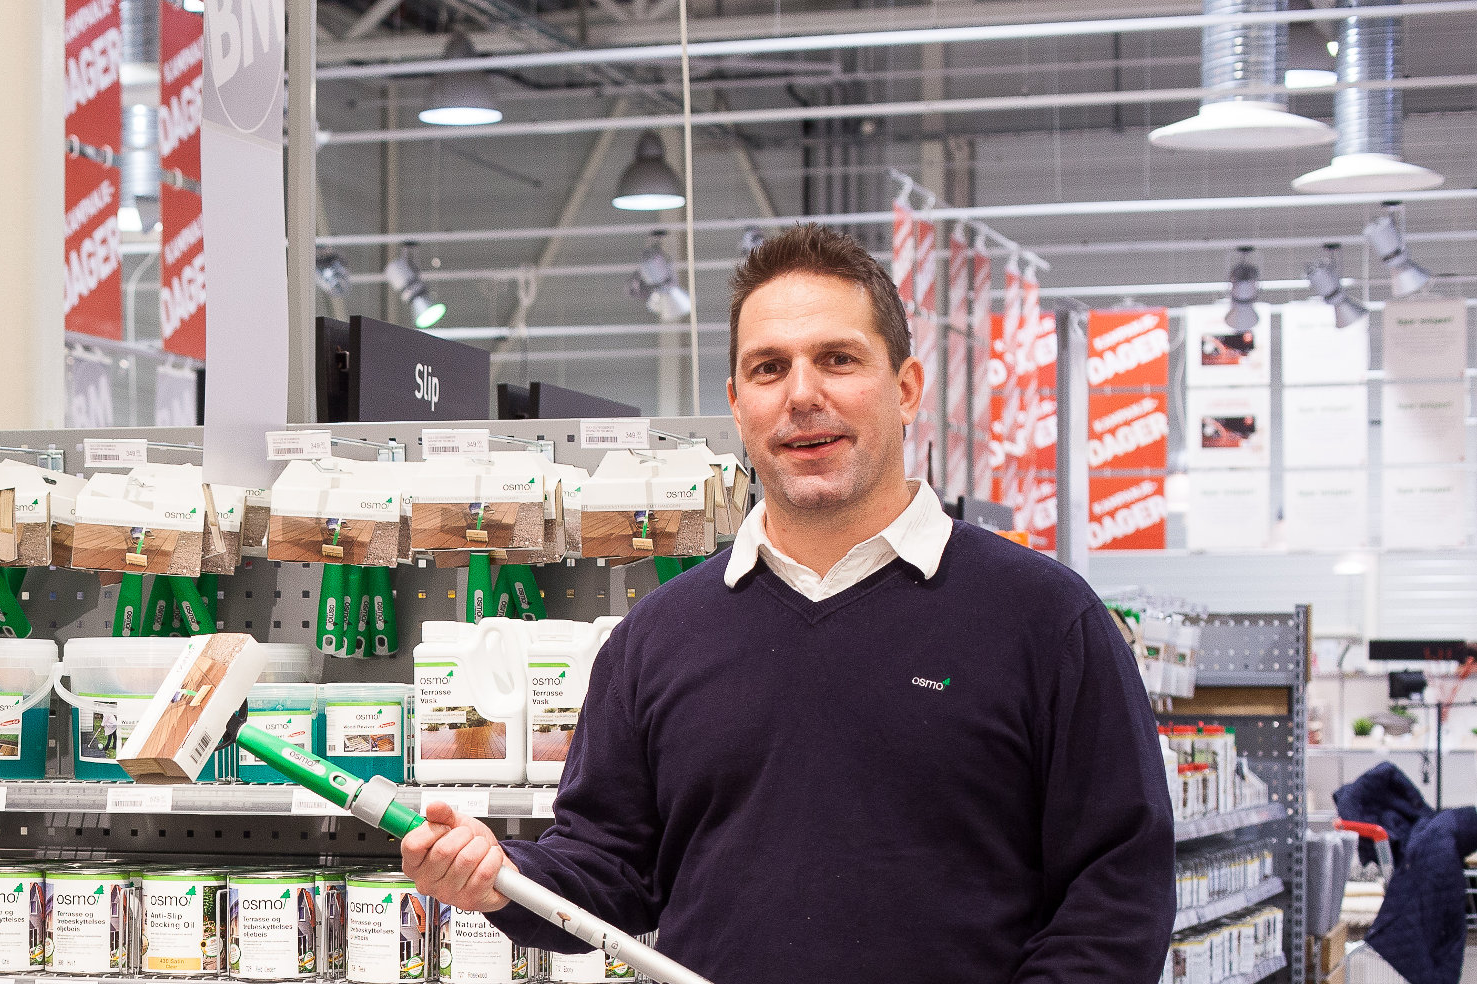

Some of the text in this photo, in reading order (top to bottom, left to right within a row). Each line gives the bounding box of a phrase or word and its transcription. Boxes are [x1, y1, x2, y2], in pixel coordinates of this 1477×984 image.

[415, 363, 440, 411] Slip
[502, 482, 532, 492] osmo
[666, 490, 695, 499] osmo
[360, 501, 390, 510] osmo
[165, 511, 193, 520] osmo
[419, 675, 449, 685] osmo
[532, 676, 561, 686] osmo
[911, 675, 943, 691] osmo
[289, 750, 317, 768] osmo
[57, 894, 96, 905] osmo
[151, 895, 188, 906] osmo
[242, 899, 283, 910] osmo
[150, 912, 182, 920] Anti-Slip
[150, 921, 180, 929] Decking
[455, 921, 487, 929] Natural
[455, 929, 501, 937] Woodstain
